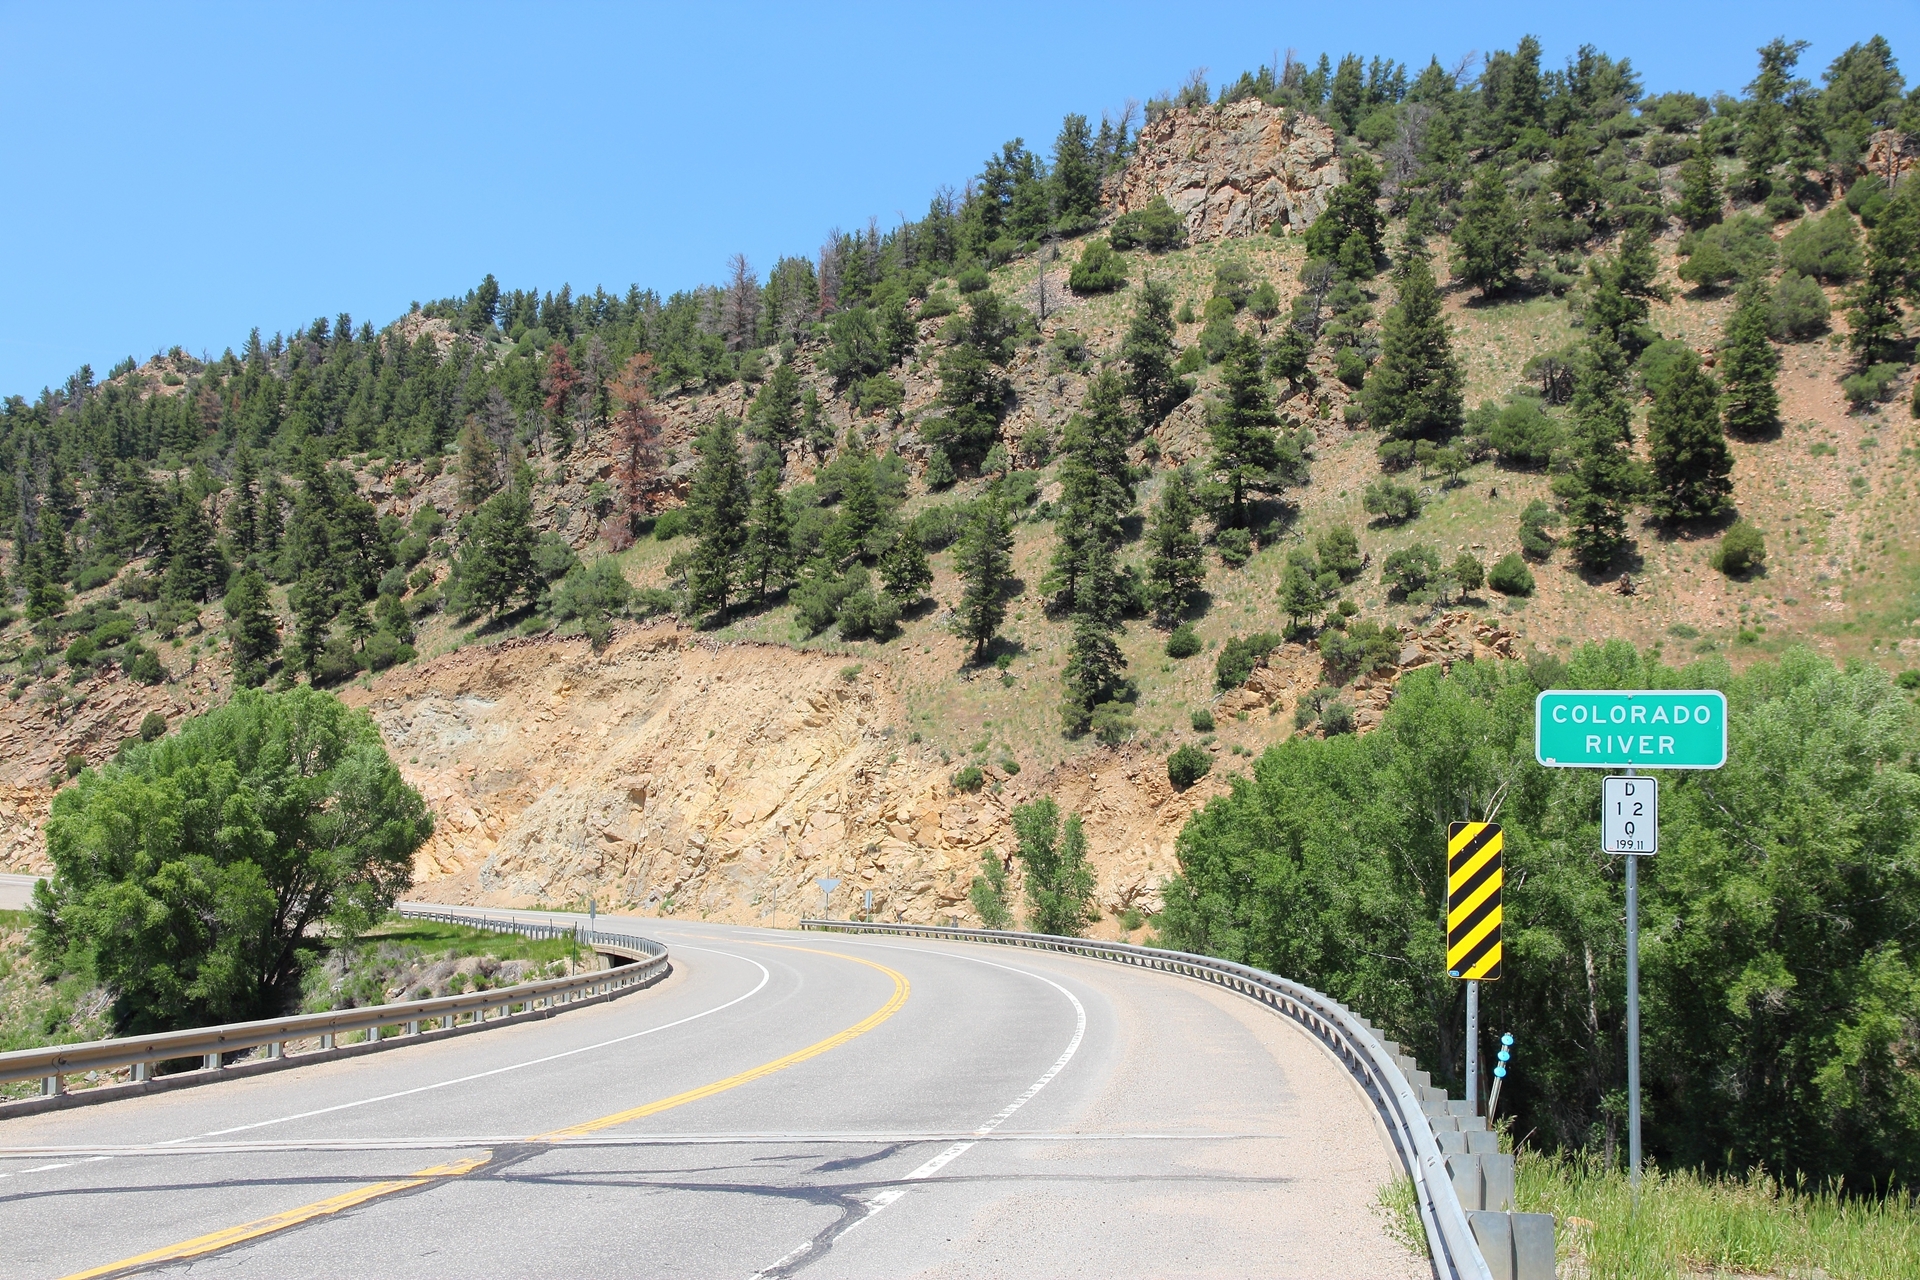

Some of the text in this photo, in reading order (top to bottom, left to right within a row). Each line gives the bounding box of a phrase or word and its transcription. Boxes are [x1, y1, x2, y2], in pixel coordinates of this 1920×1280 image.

[1552, 704, 1711, 725] COLORADO
[1586, 735, 1675, 755] RIVER
[1625, 782, 1635, 796] D
[1624, 821, 1635, 836] Q
[1616, 839, 1644, 850] 199.11
